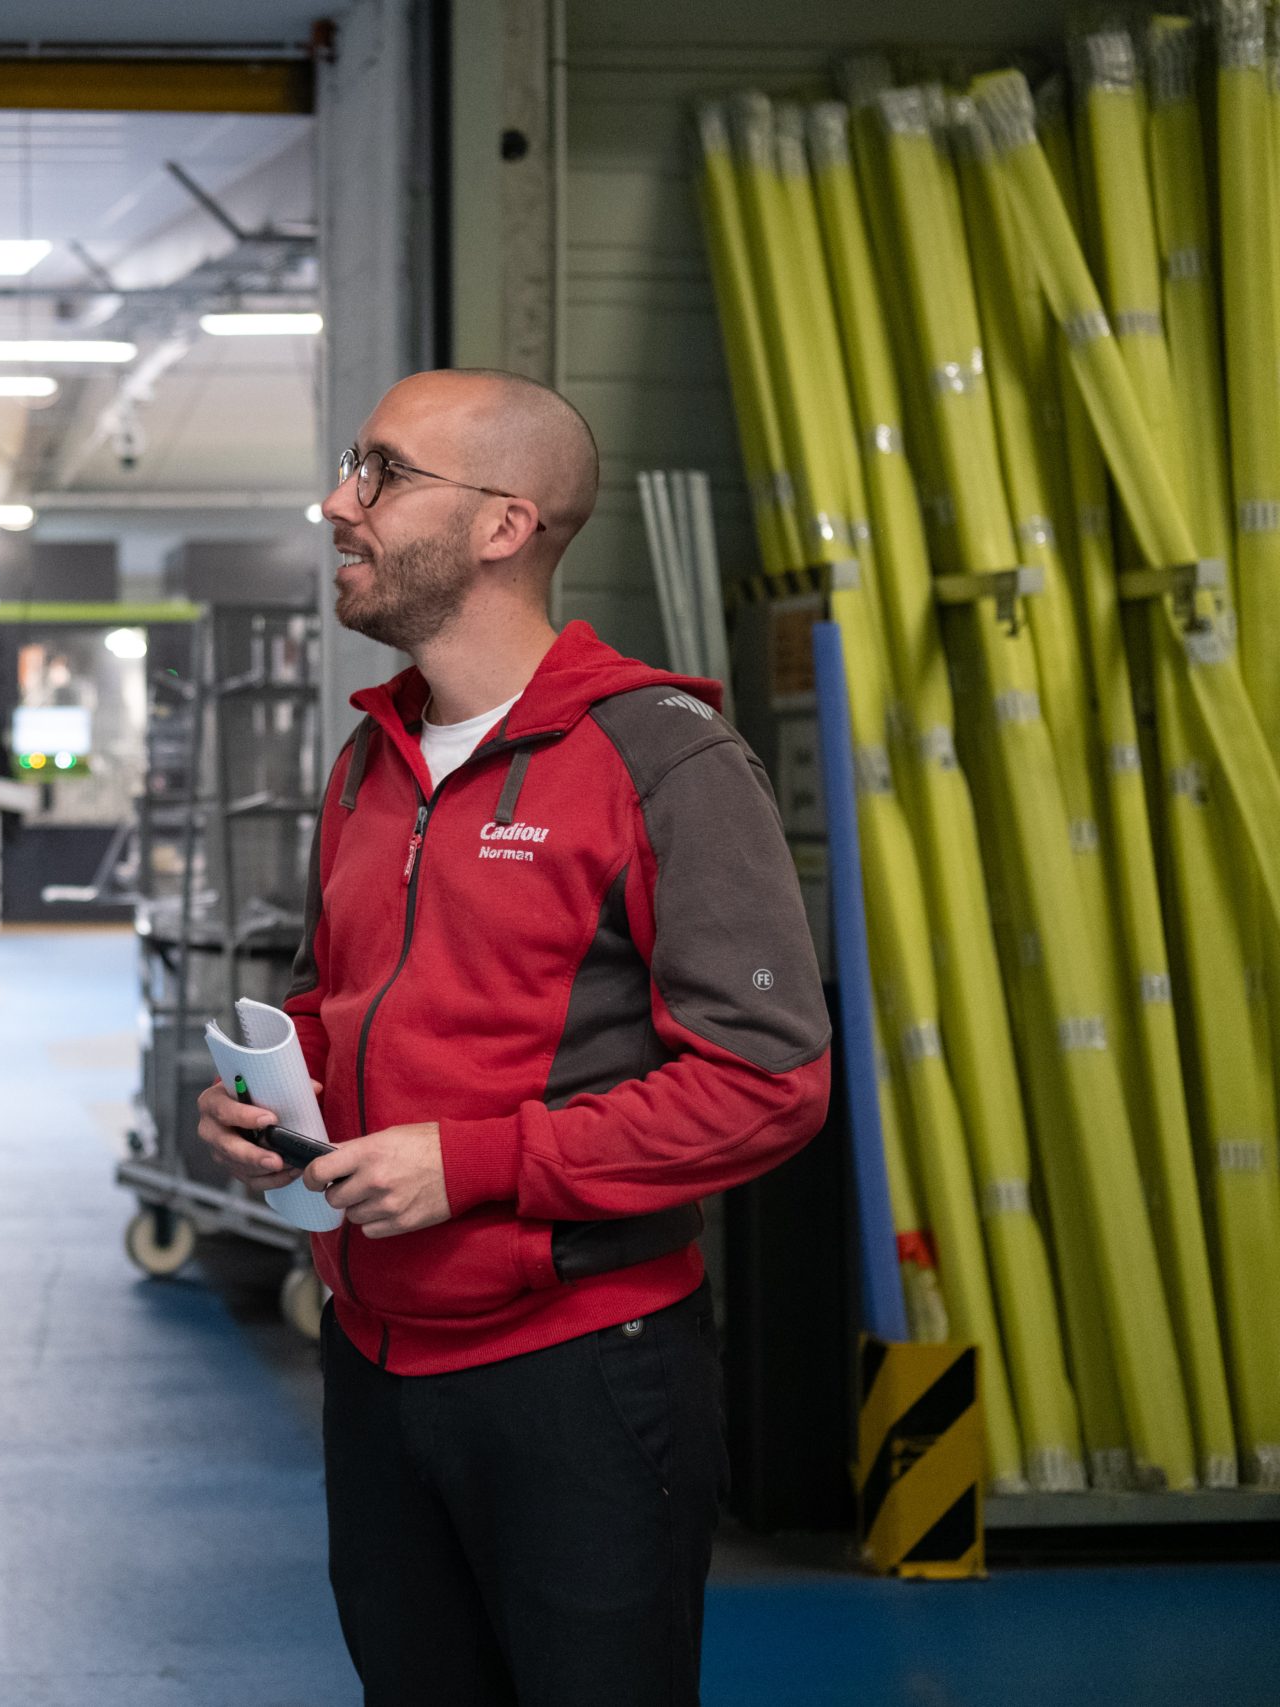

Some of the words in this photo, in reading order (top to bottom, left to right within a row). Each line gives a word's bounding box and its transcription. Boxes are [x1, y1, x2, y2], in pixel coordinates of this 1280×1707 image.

[480, 822, 549, 842] Cadiou
[478, 846, 534, 862] Norman
[757, 973, 770, 985] FE
